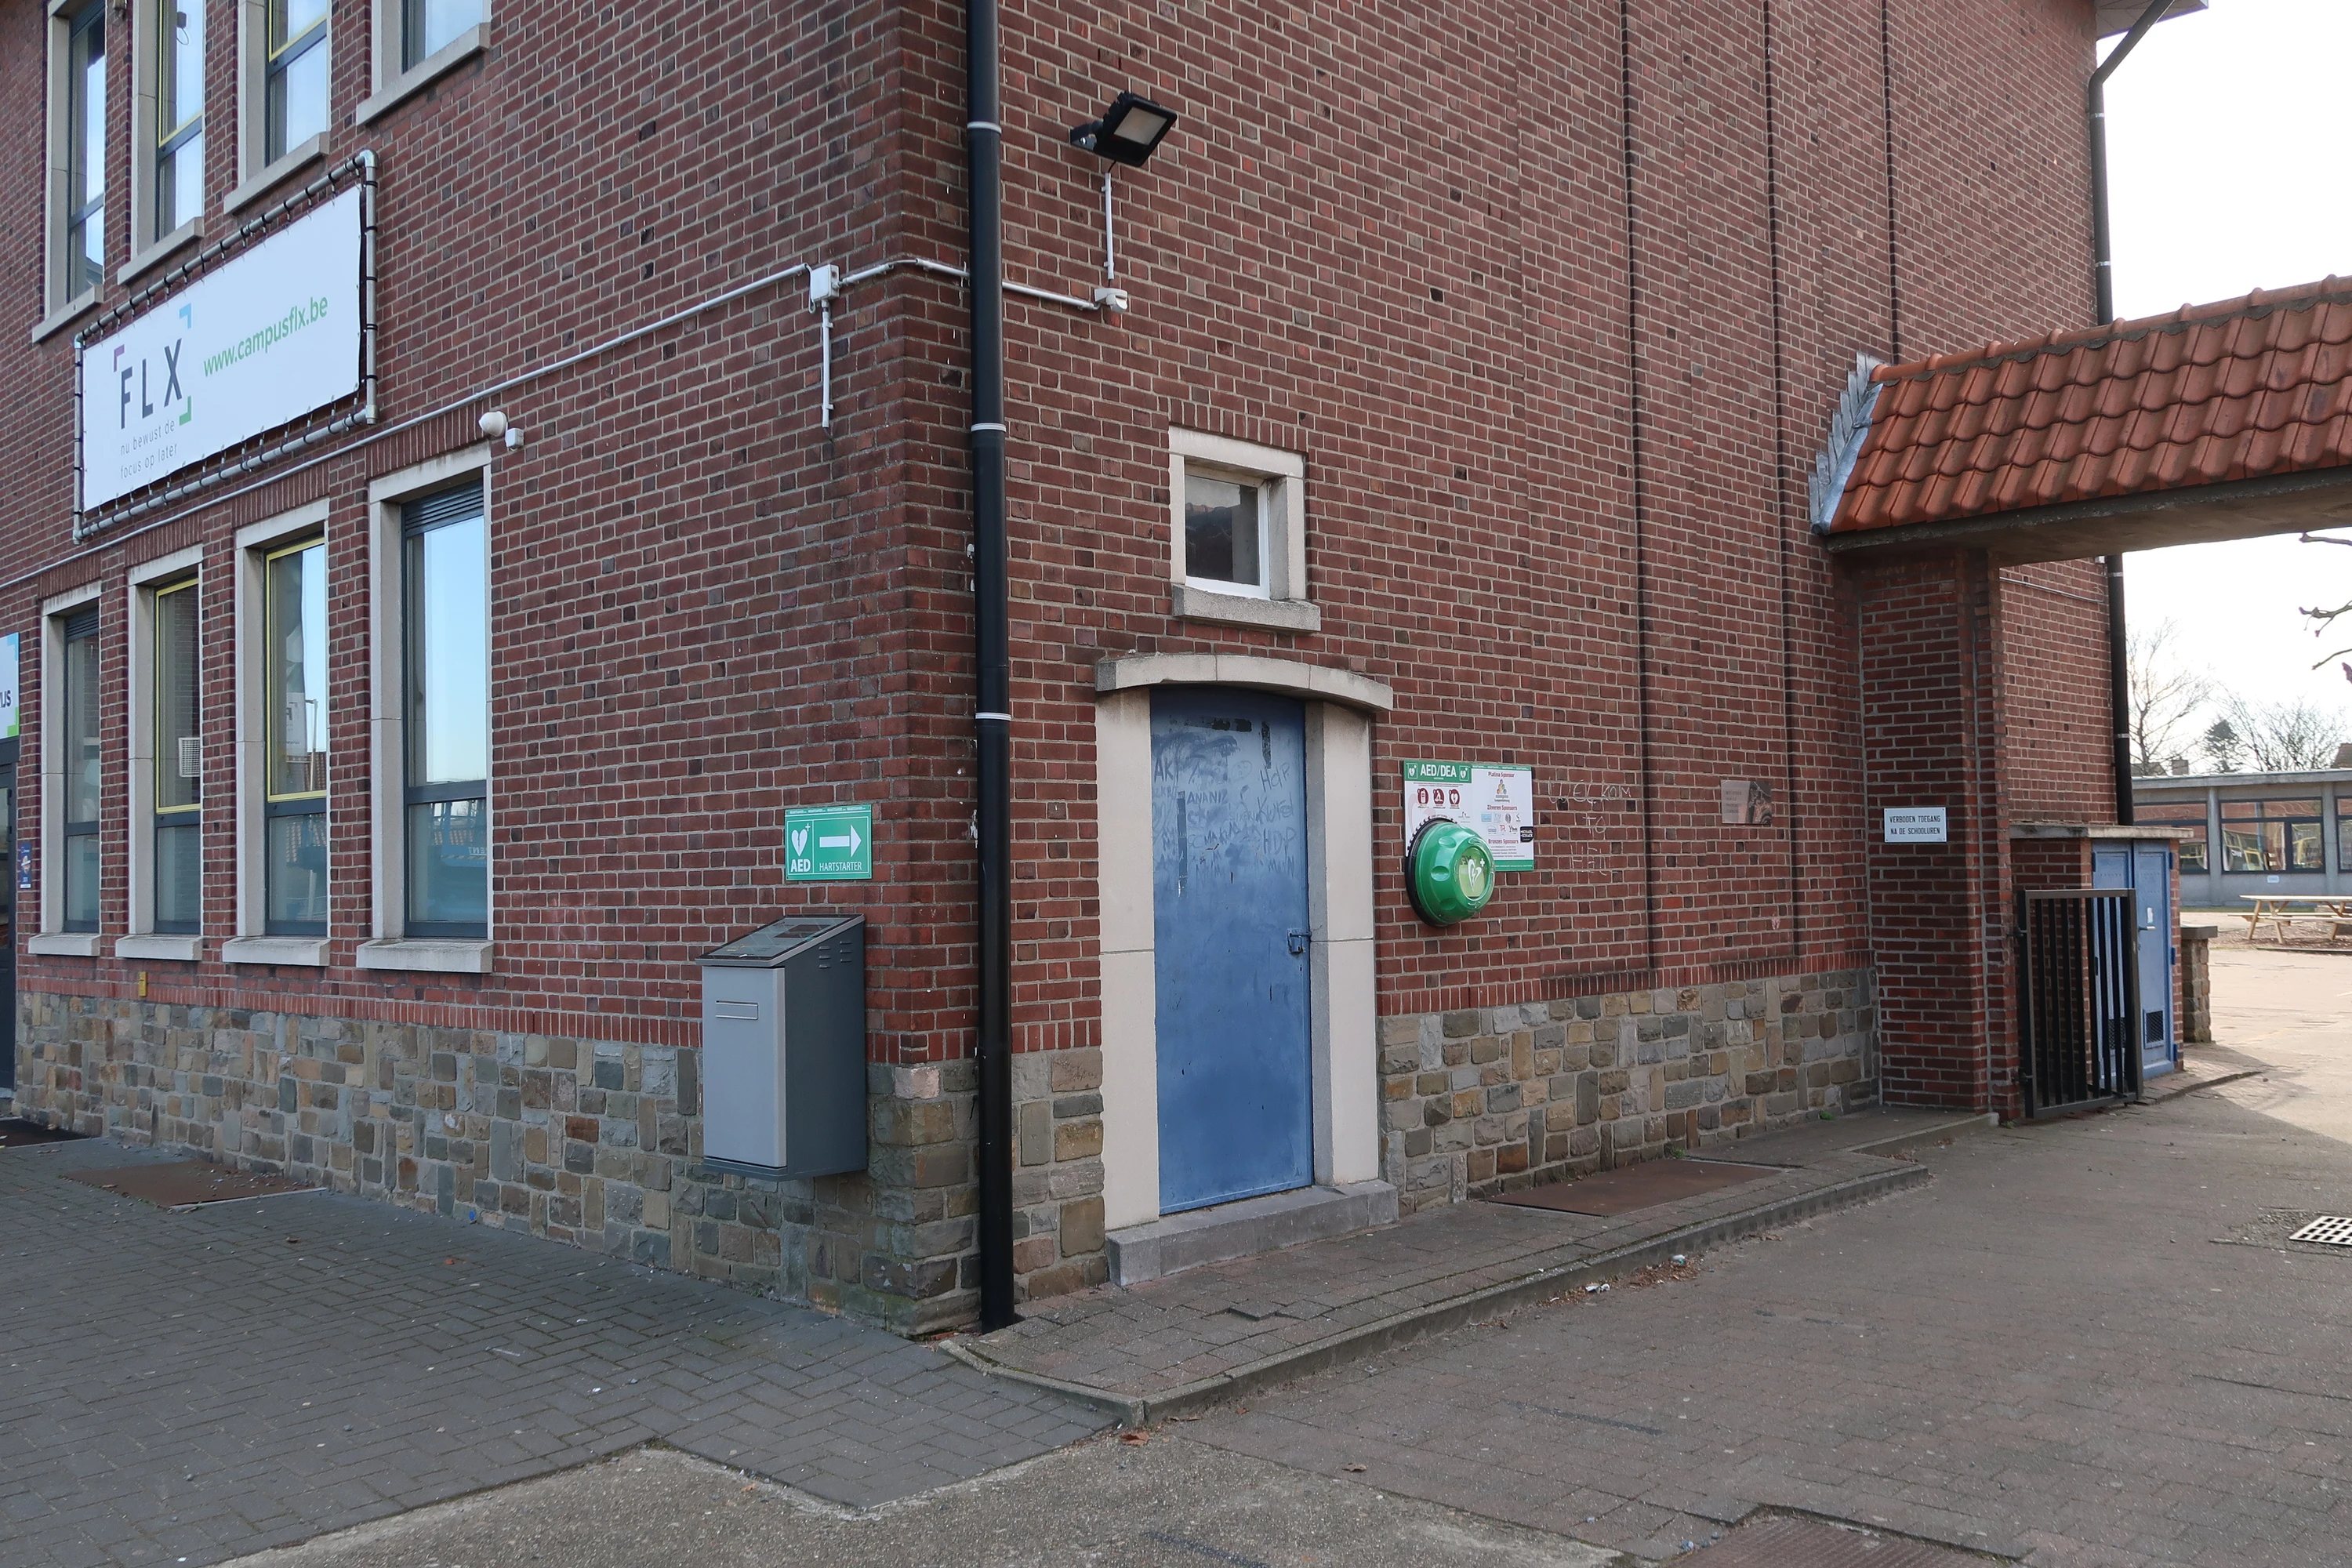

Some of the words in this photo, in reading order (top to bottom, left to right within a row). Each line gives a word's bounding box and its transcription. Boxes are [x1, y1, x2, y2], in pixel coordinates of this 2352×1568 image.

[203, 296, 328, 377] www.campusflx.be
[121, 337, 183, 430] FLX
[120, 442, 130, 456] nu
[132, 426, 162, 450] bewust
[165, 419, 175, 434] de
[120, 459, 142, 479] focus
[144, 454, 154, 470] op
[158, 443, 178, 462] later
[1420, 764, 1457, 777] AED/DEA
[1582, 815, 1606, 834] TO
[790, 858, 811, 873] AED
[819, 861, 862, 872] HARTSTARTER
